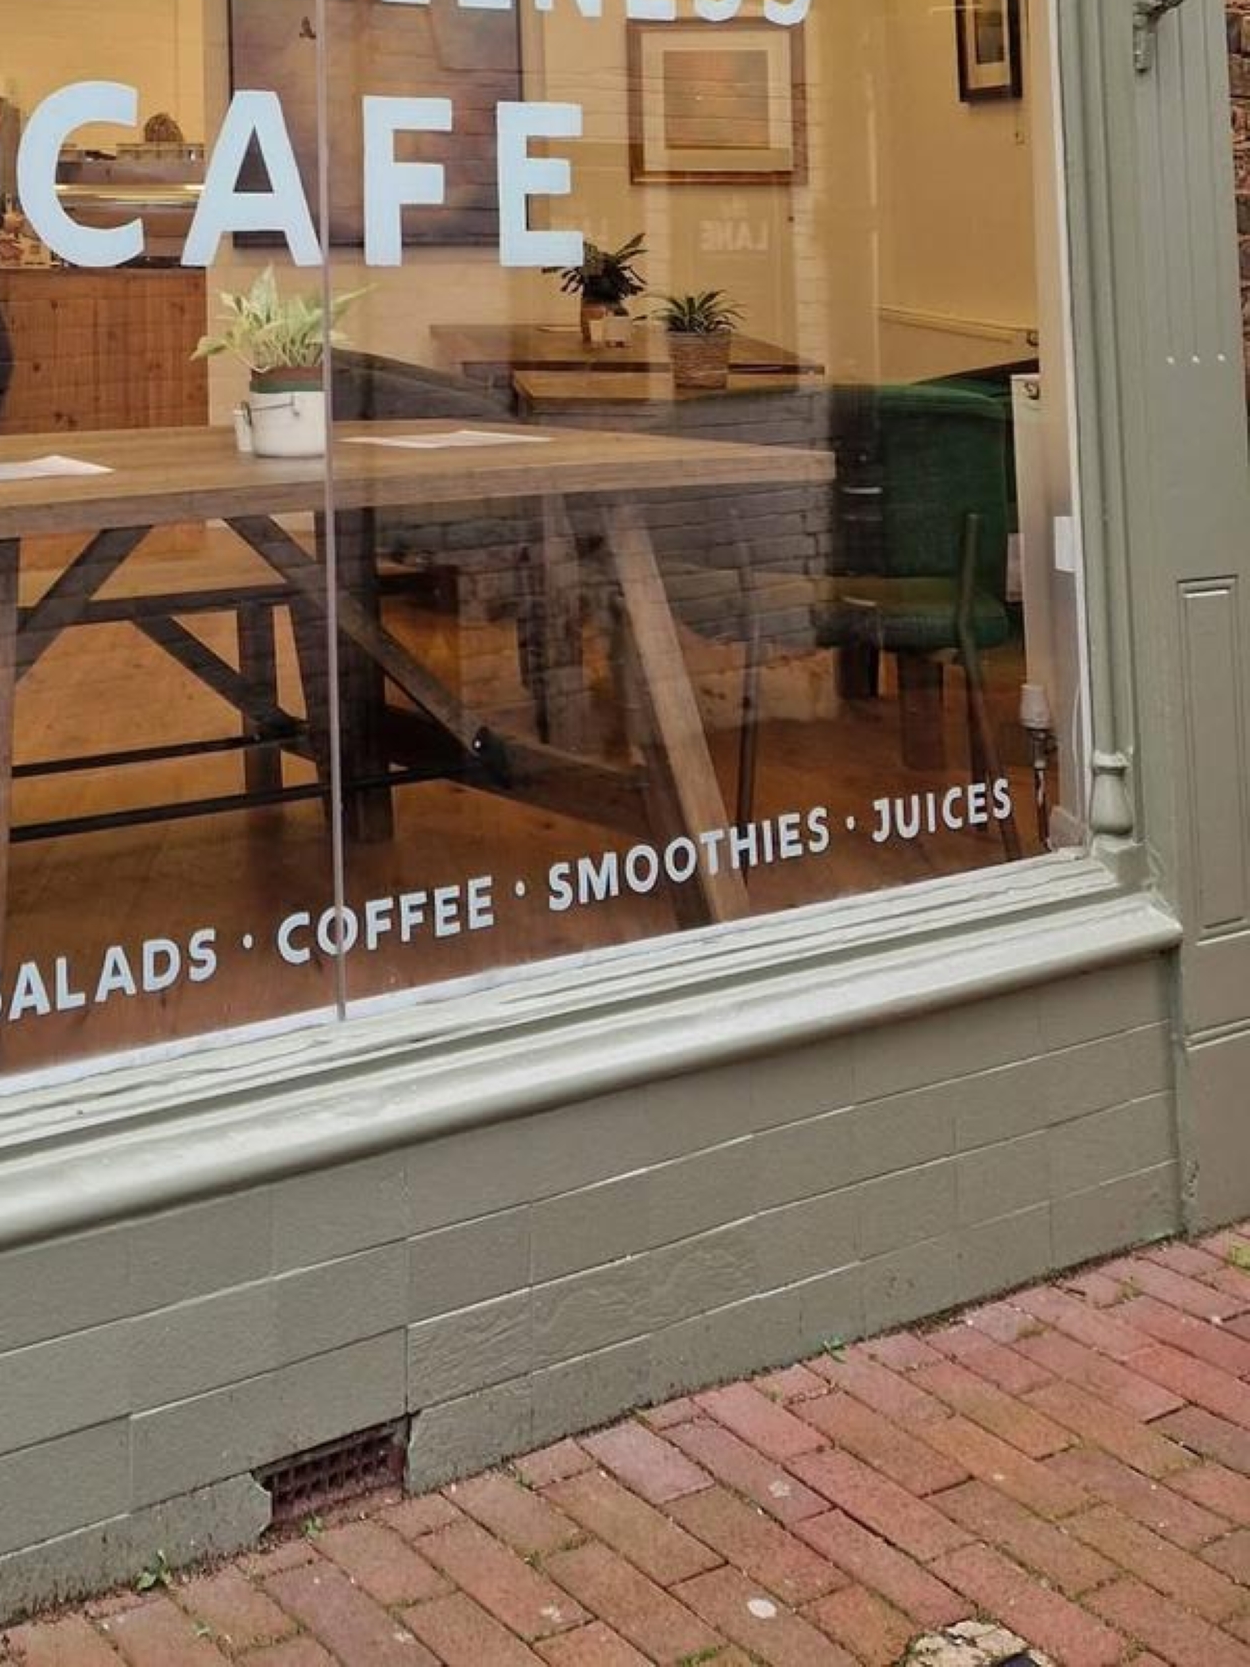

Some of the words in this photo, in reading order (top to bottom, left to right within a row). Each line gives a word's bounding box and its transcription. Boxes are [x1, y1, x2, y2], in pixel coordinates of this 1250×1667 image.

[16, 80, 585, 268] CAFE
[276, 875, 495, 965] COFFEE
[548, 806, 829, 911] SMOOTHIES
[871, 777, 1013, 843] JUICES
